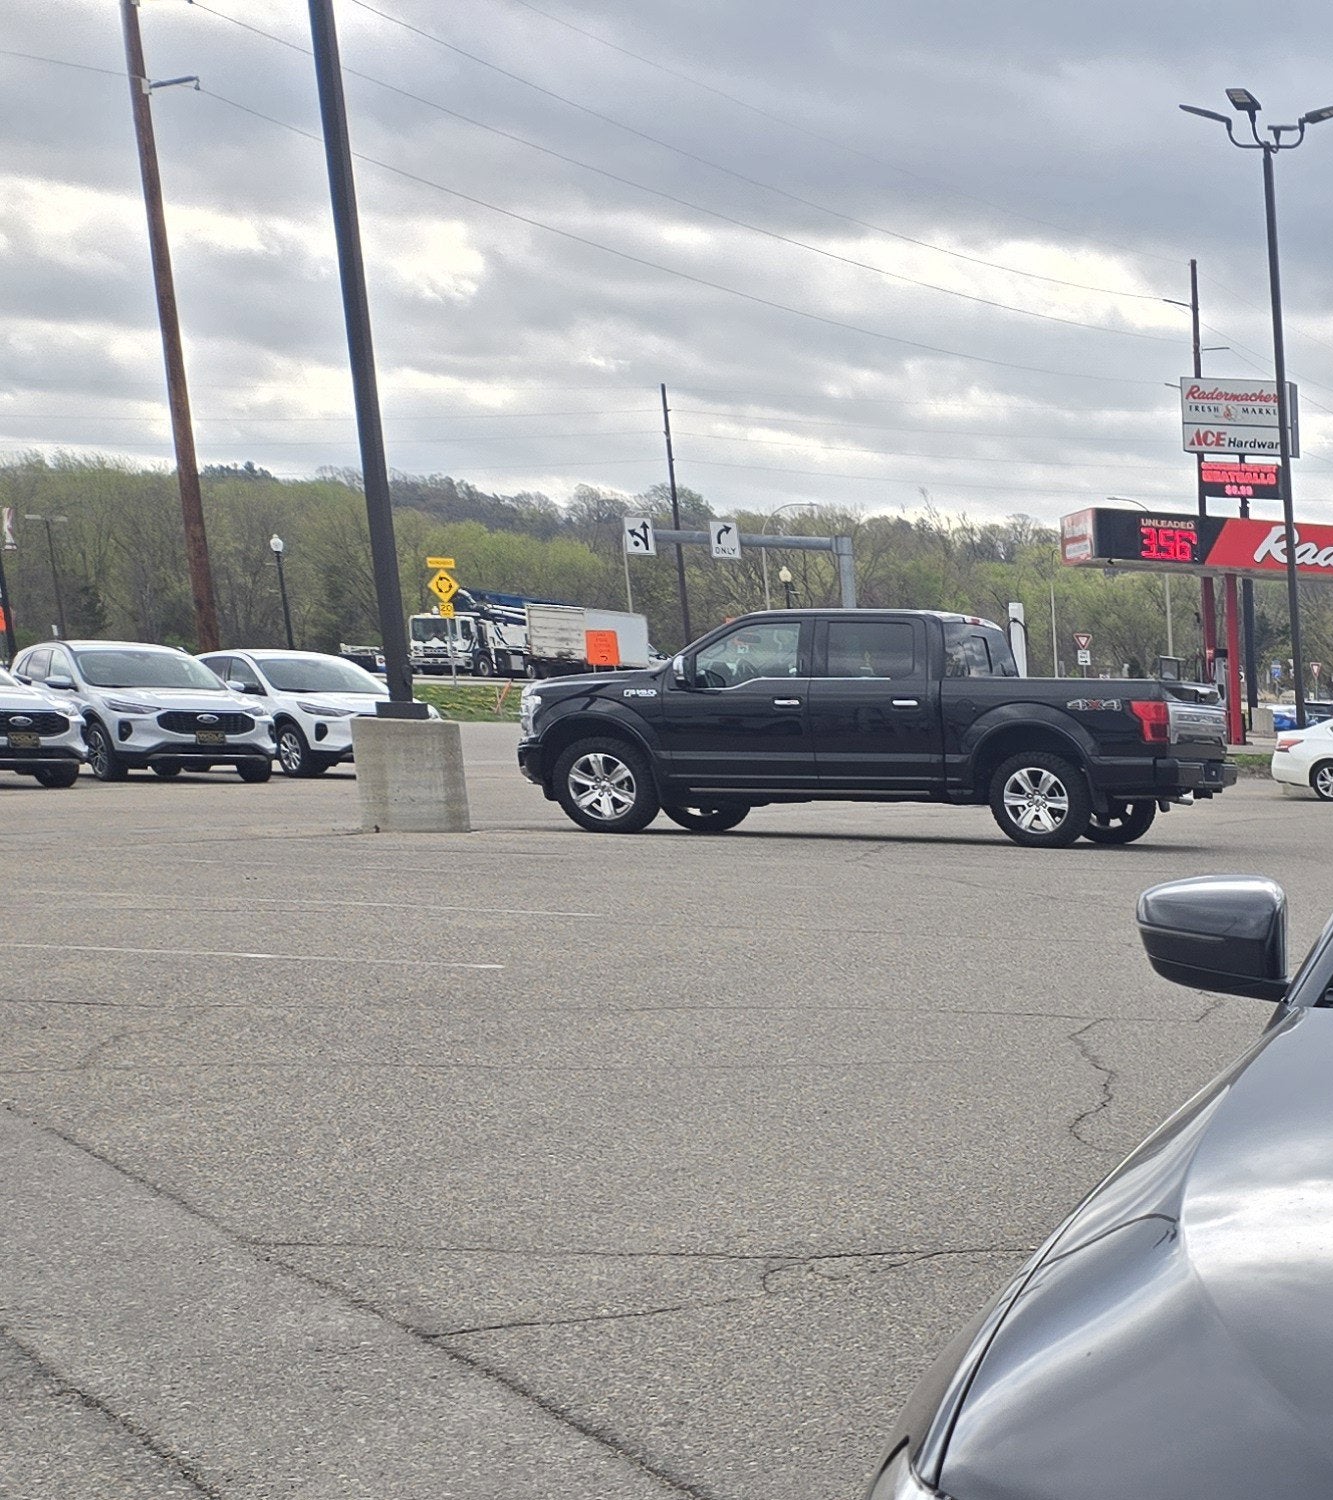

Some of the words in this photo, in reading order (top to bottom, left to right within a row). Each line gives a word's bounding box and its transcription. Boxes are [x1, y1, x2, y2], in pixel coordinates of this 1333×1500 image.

[1185, 385, 1280, 404] Radermacher
[1189, 405, 1219, 413] FRESH
[1241, 407, 1278, 416] MARKE
[1189, 428, 1227, 447] ACE
[1227, 438, 1280, 450] Hardwar
[1141, 518, 1195, 530] UNLEADED
[715, 546, 736, 555] ONLY
[440, 604, 452, 612] 20
